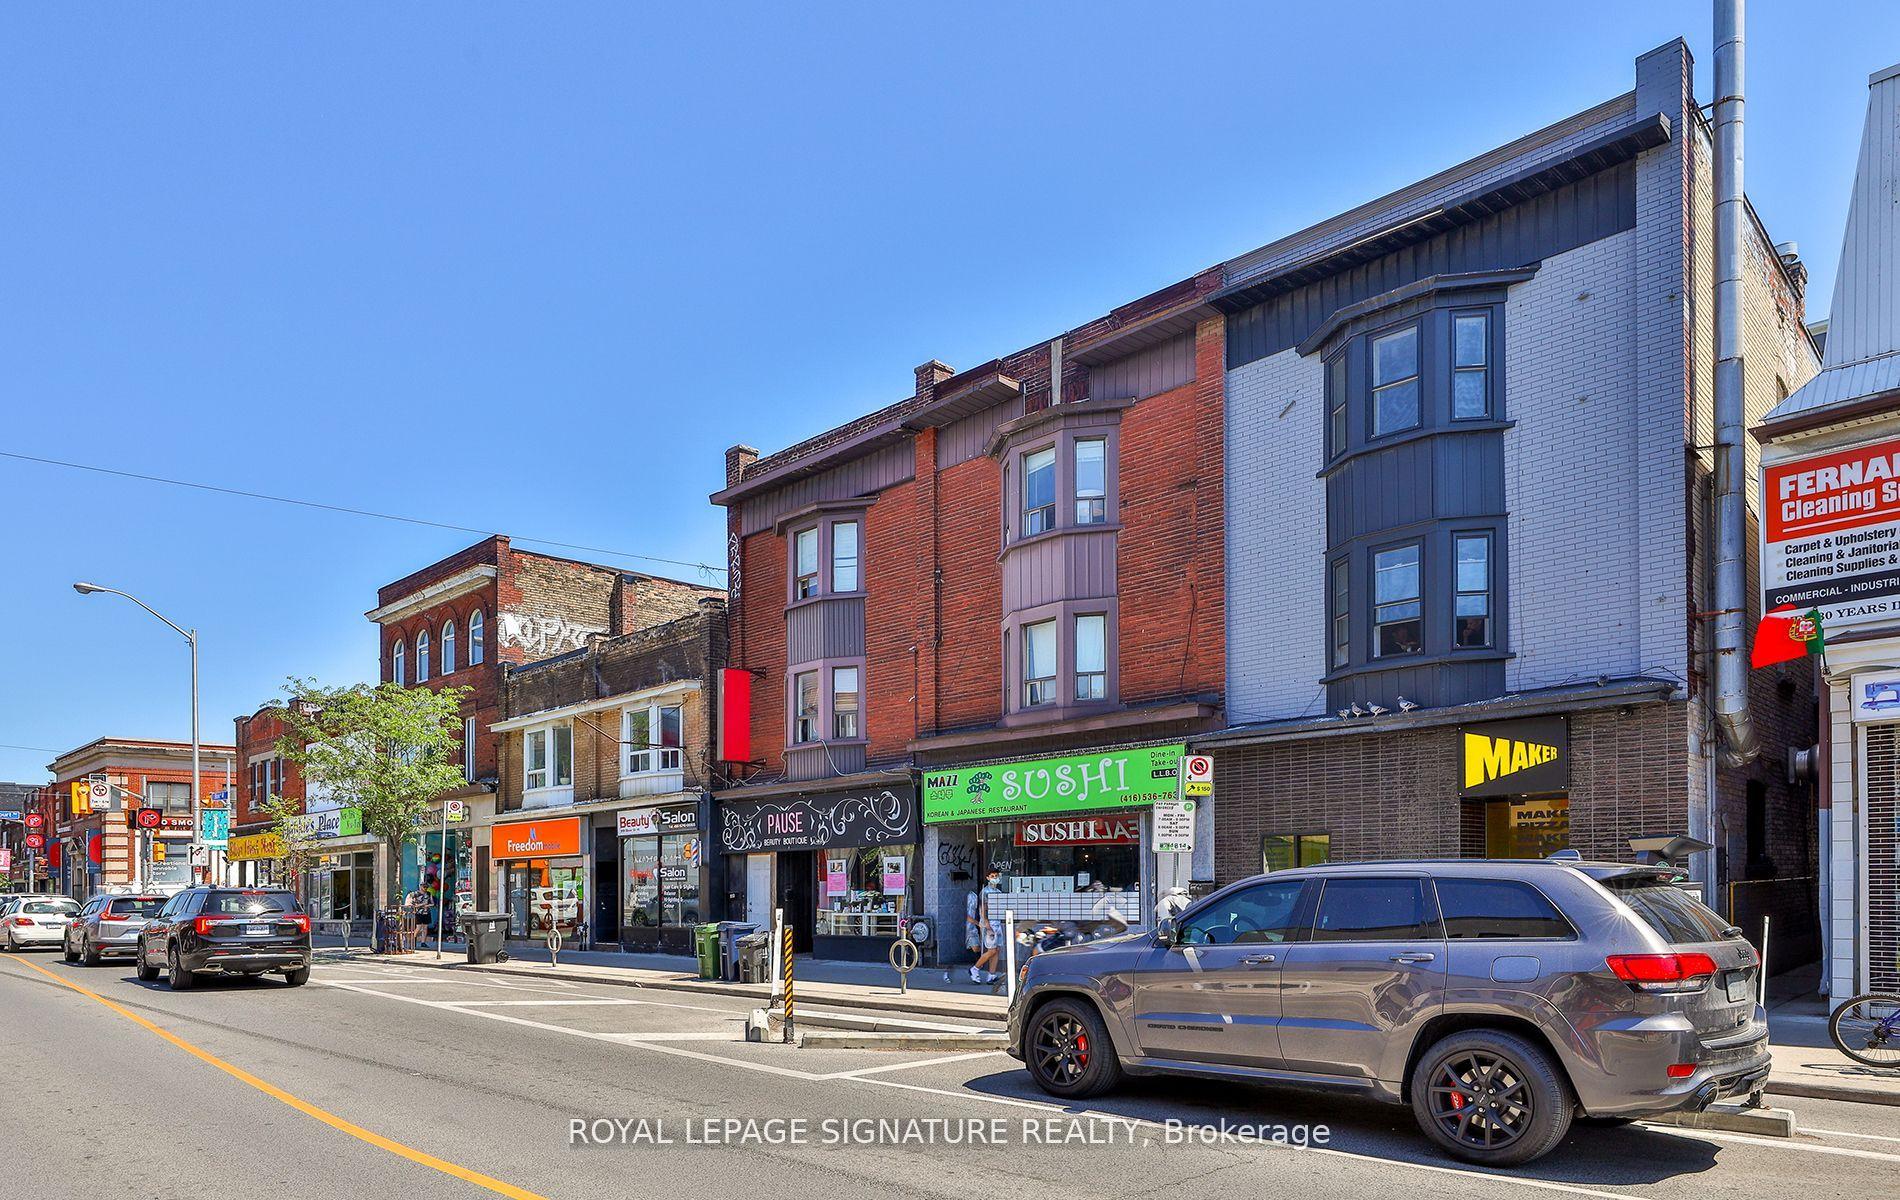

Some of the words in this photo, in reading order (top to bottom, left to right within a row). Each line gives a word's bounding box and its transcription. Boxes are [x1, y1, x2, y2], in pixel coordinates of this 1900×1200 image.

[1780, 452, 1900, 501] FERNA
[1781, 490, 1876, 522] Cleaning
[1882, 481, 1900, 503] S
[1785, 541, 1823, 555] Carpet
[1823, 538, 1832, 548] &
[1835, 527, 1897, 546] Upholstery
[1785, 552, 1833, 569] Cleaning
[1836, 550, 1845, 560] &
[1848, 541, 1900, 558] Janitoria
[1786, 565, 1834, 581] Cleaning
[1836, 557, 1885, 573] Supplies
[1888, 554, 1898, 565] &
[1775, 586, 1842, 604] COMMERCIAL
[1836, 603, 1888, 618] YEARS
[1151, 759, 1178, 767] Take-ou
[1464, 733, 1558, 789] MAKER
[927, 774, 958, 789] MAZZ
[1002, 757, 1130, 801] SUSHI
[620, 814, 650, 829] Beauty
[661, 810, 696, 825] Salon
[927, 809, 949, 818] KOREAN
[957, 807, 986, 816] JAPANESE
[988, 804, 1028, 814] RESTAURANT
[171, 819, 194, 827] SMO
[318, 813, 340, 831] Place
[767, 811, 804, 835] PAUSE
[1026, 819, 1097, 843] SUSHI
[507, 837, 544, 852] Freedom
[763, 838, 781, 847] BEAUTY
[782, 836, 808, 846] BOUTIQUE
[660, 867, 686, 877] Salon
